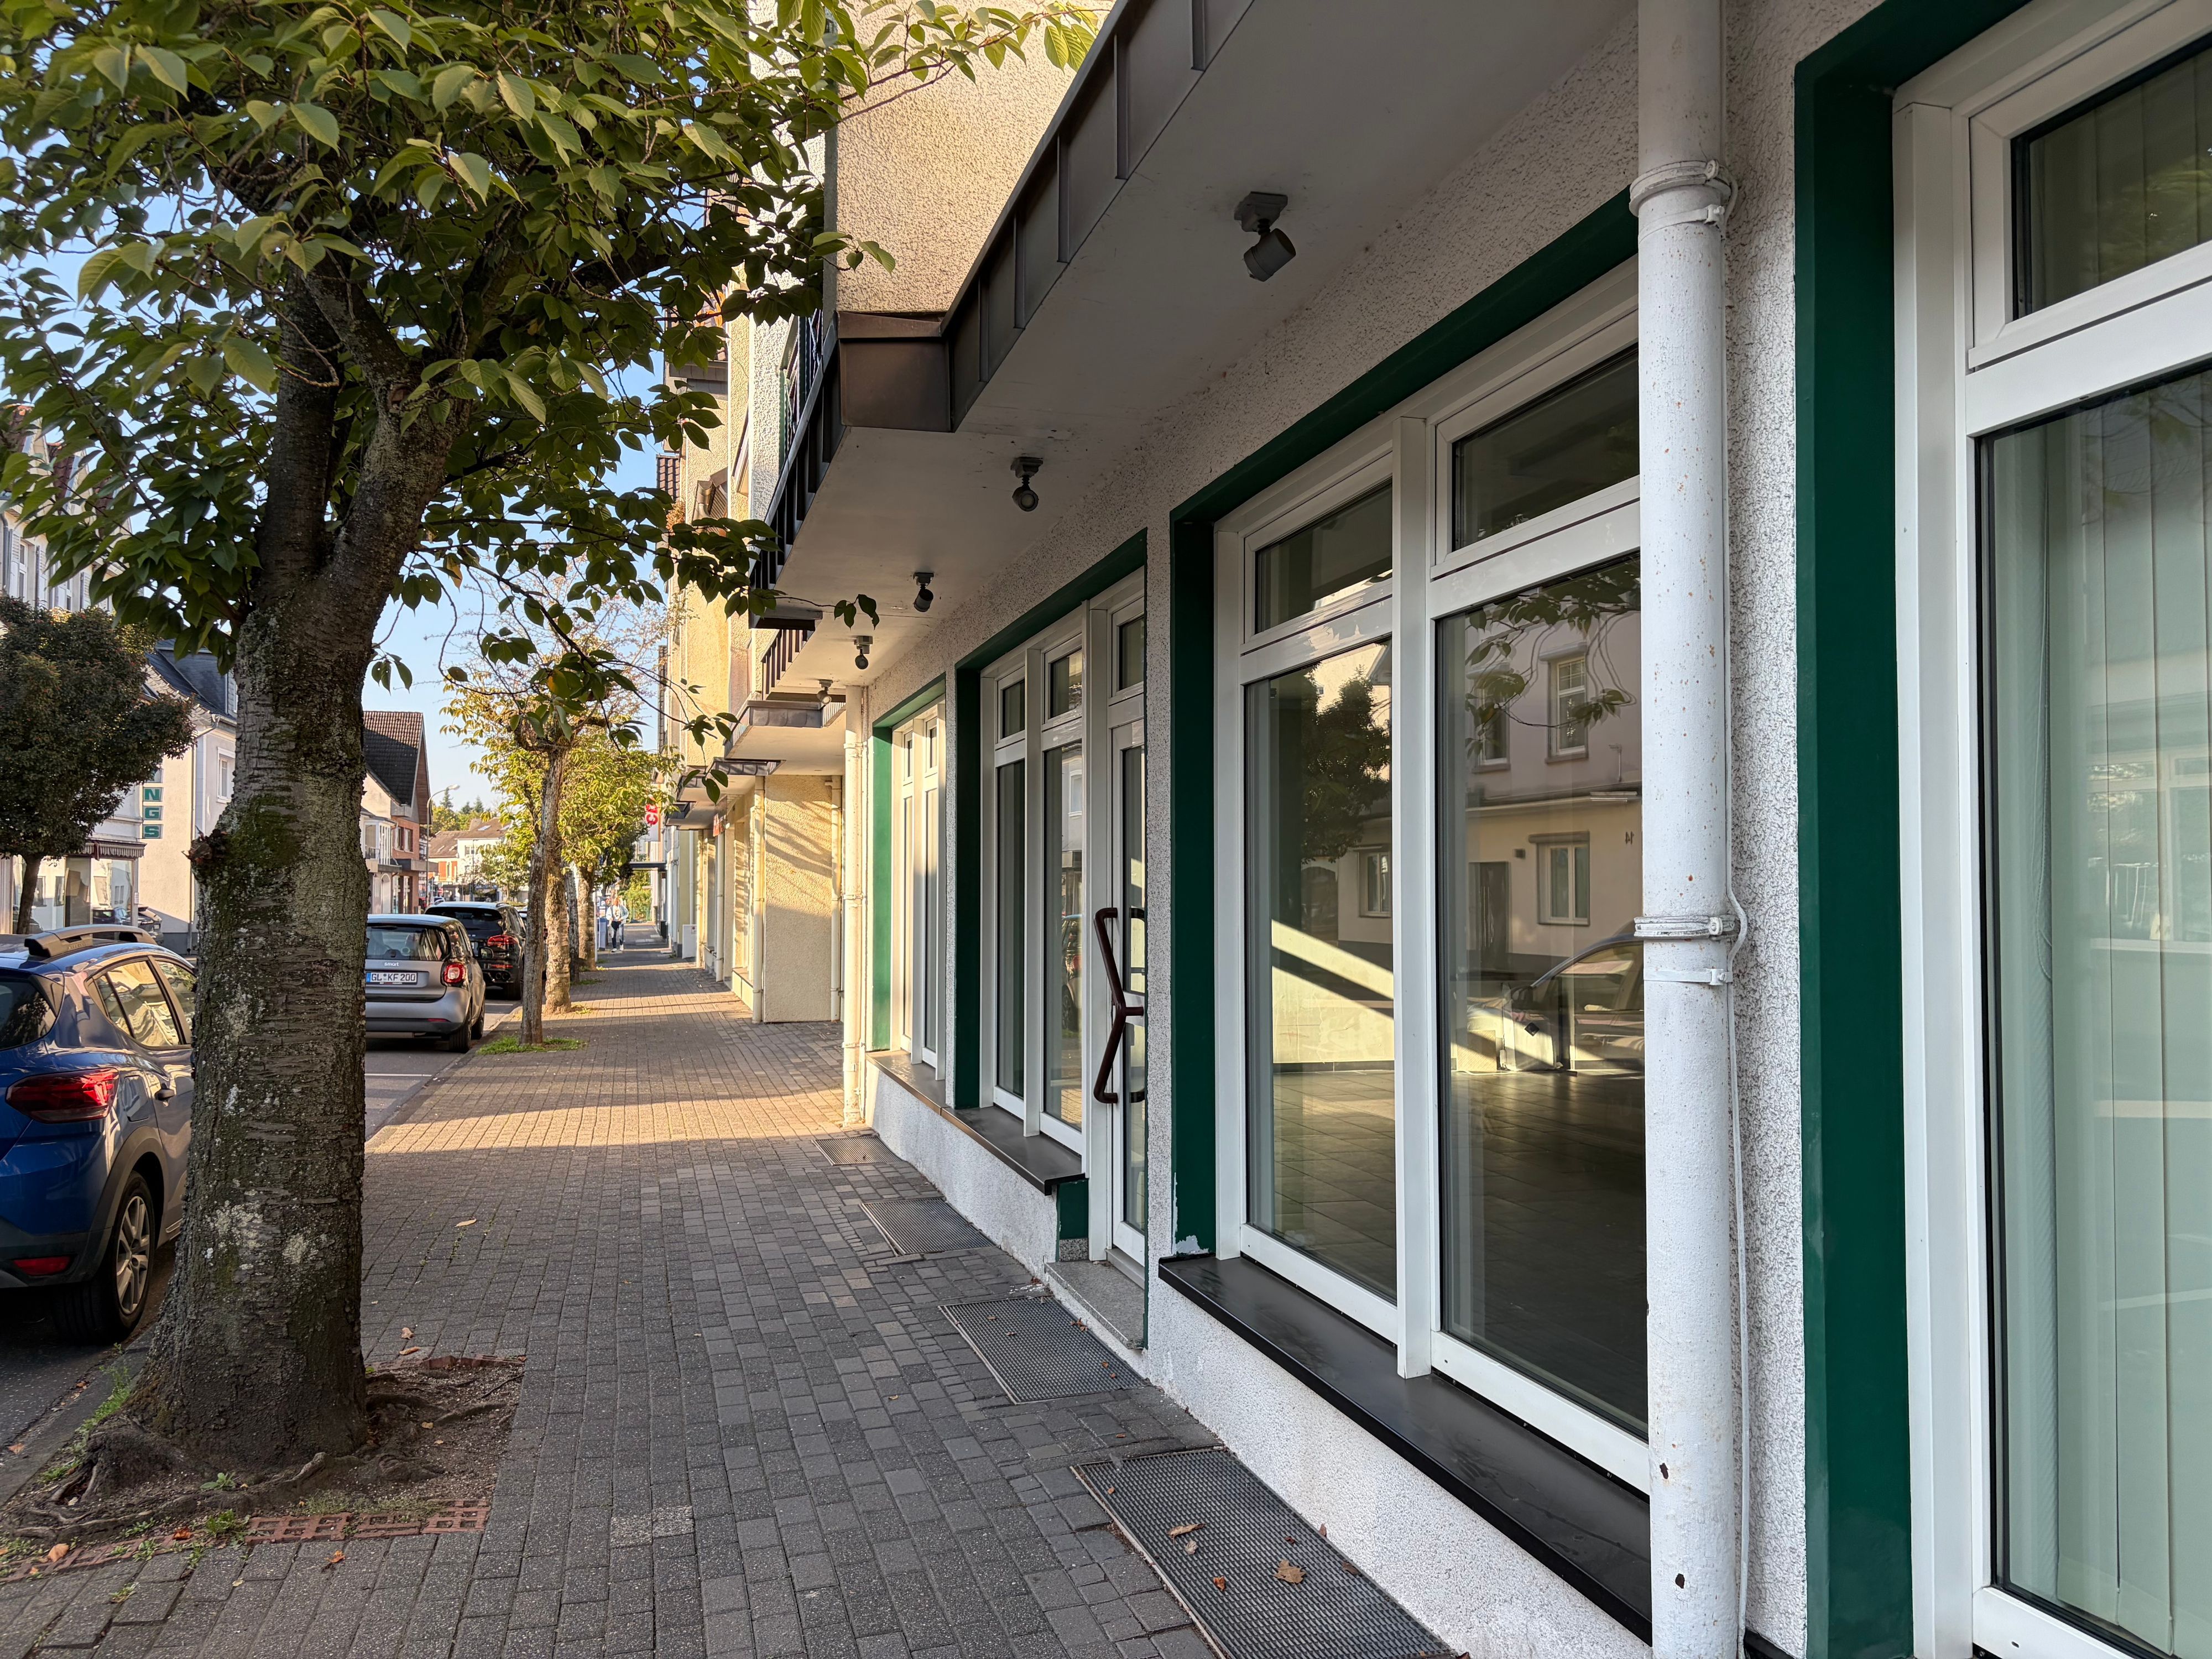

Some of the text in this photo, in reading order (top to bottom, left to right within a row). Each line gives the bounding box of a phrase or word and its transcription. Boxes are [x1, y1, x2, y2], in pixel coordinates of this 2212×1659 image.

[144, 789, 160, 837] NGS
[371, 973, 415, 982] GL KF 200
